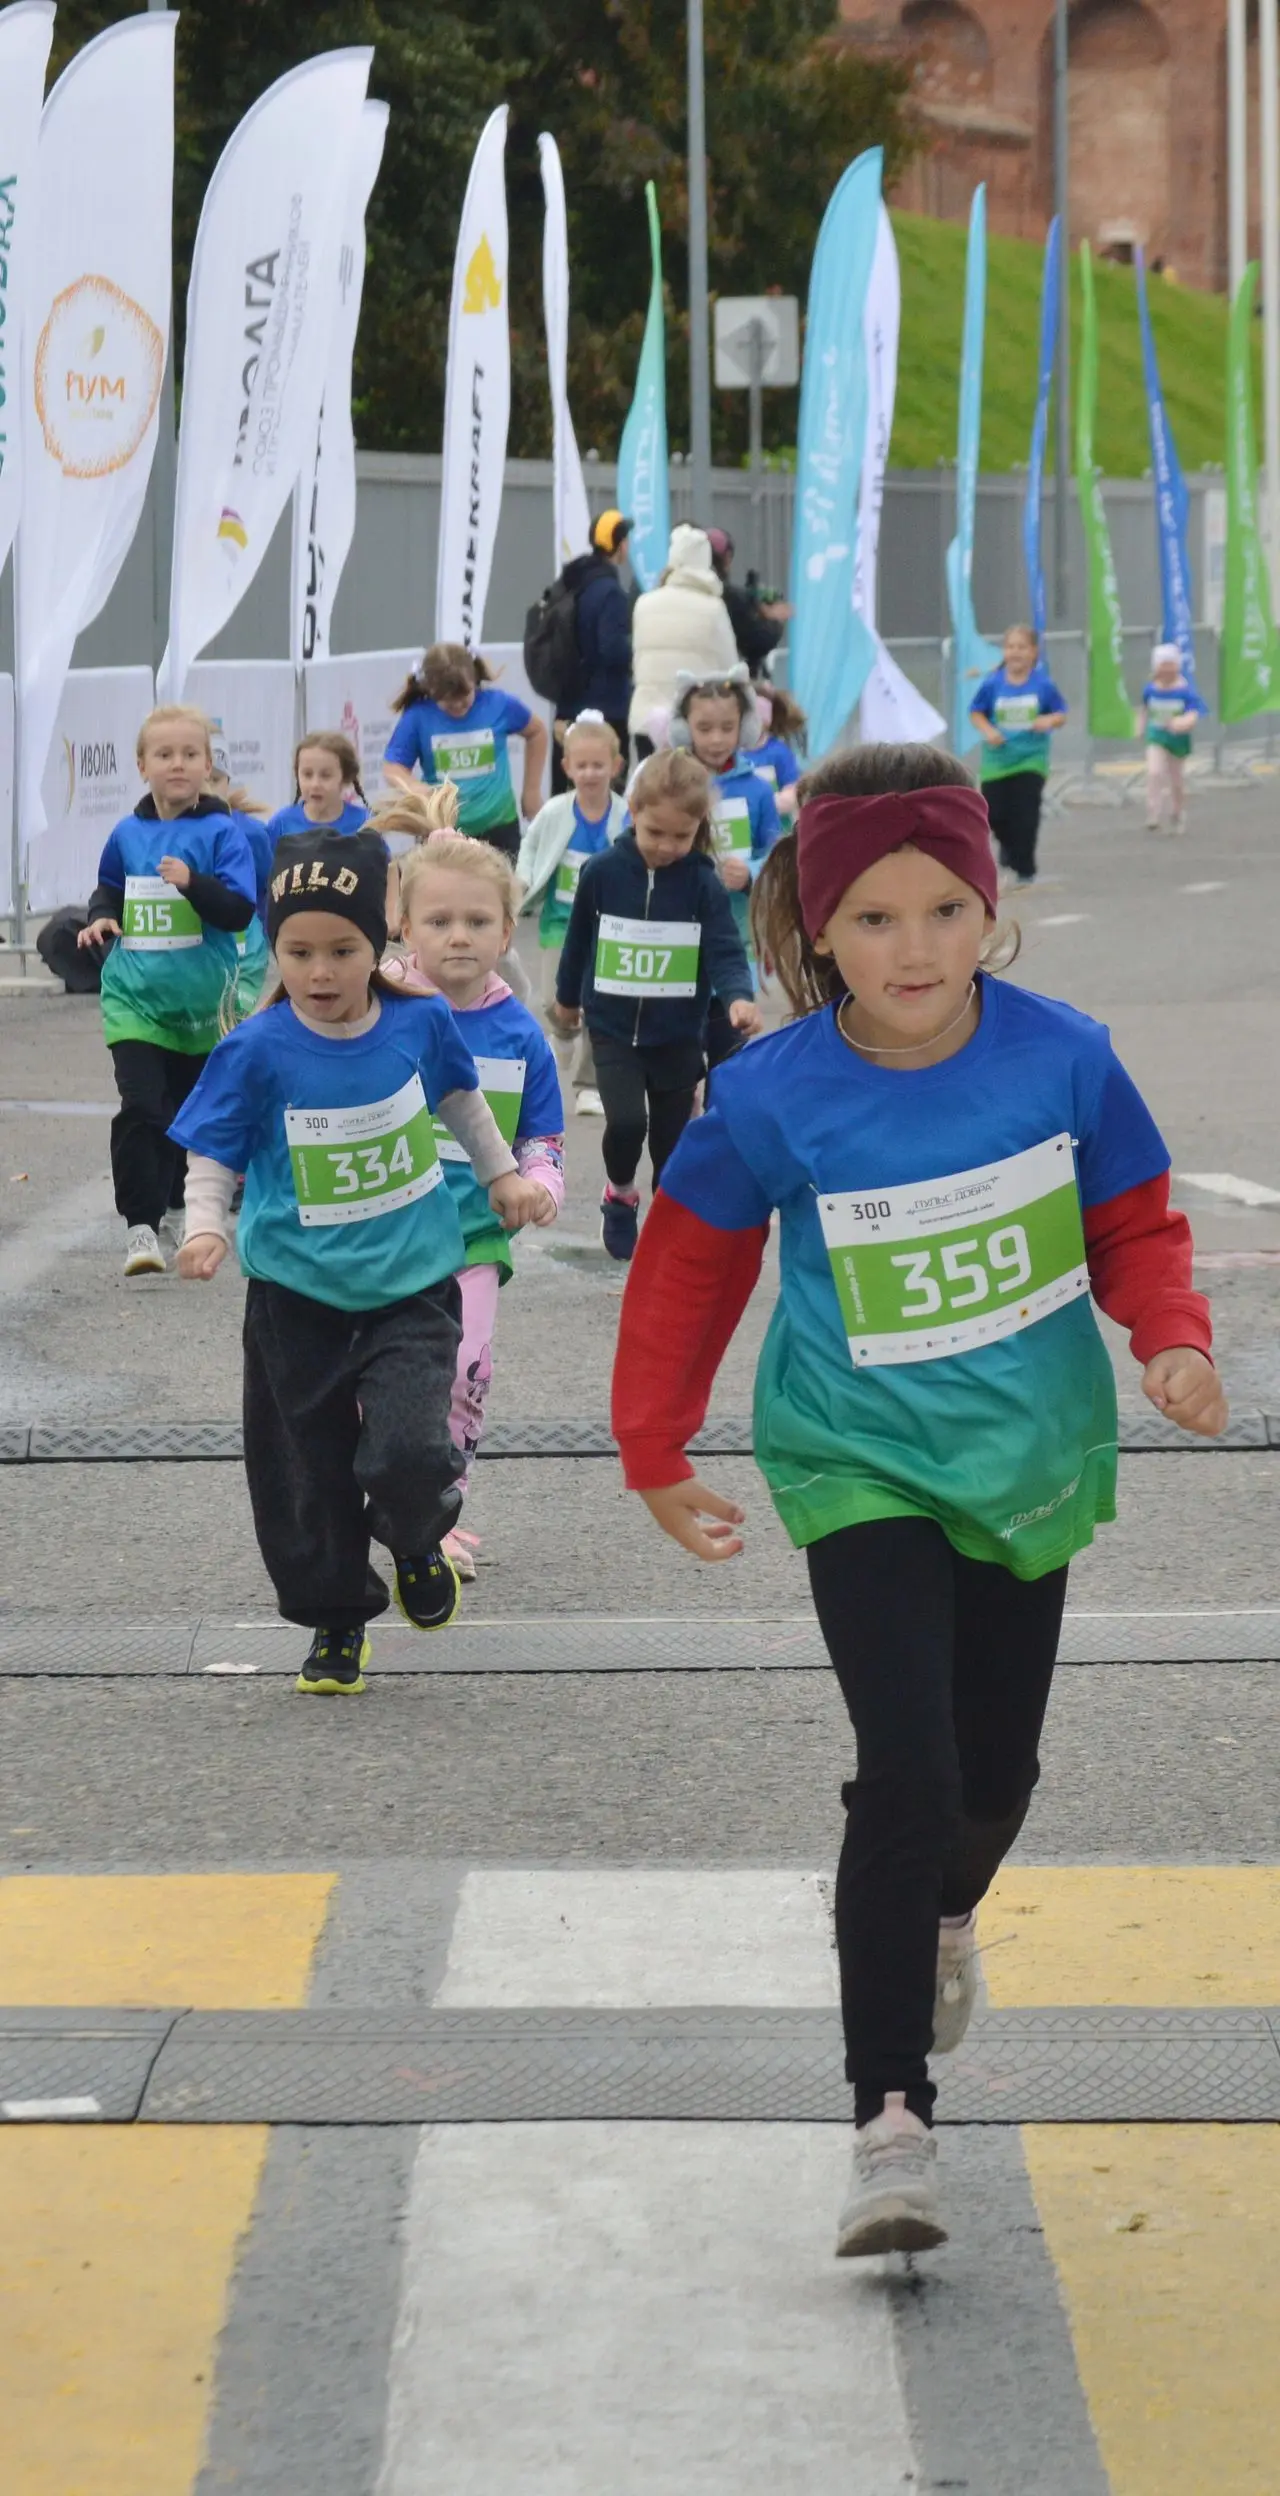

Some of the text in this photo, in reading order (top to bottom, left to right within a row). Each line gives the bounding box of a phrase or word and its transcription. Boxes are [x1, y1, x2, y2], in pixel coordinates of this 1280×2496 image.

[80, 742, 118, 778] ИВОЛГА
[449, 748, 480, 768] 367
[271, 861, 359, 903] WILD
[133, 904, 172, 932] 315
[616, 947, 672, 978] 307
[304, 1117, 328, 1129] 300
[327, 1135, 413, 1195] 334
[850, 1201, 891, 1220] 300
[913, 1184, 993, 1210] ПУЛЬС ДОБРА
[891, 1225, 1032, 1317] 359
